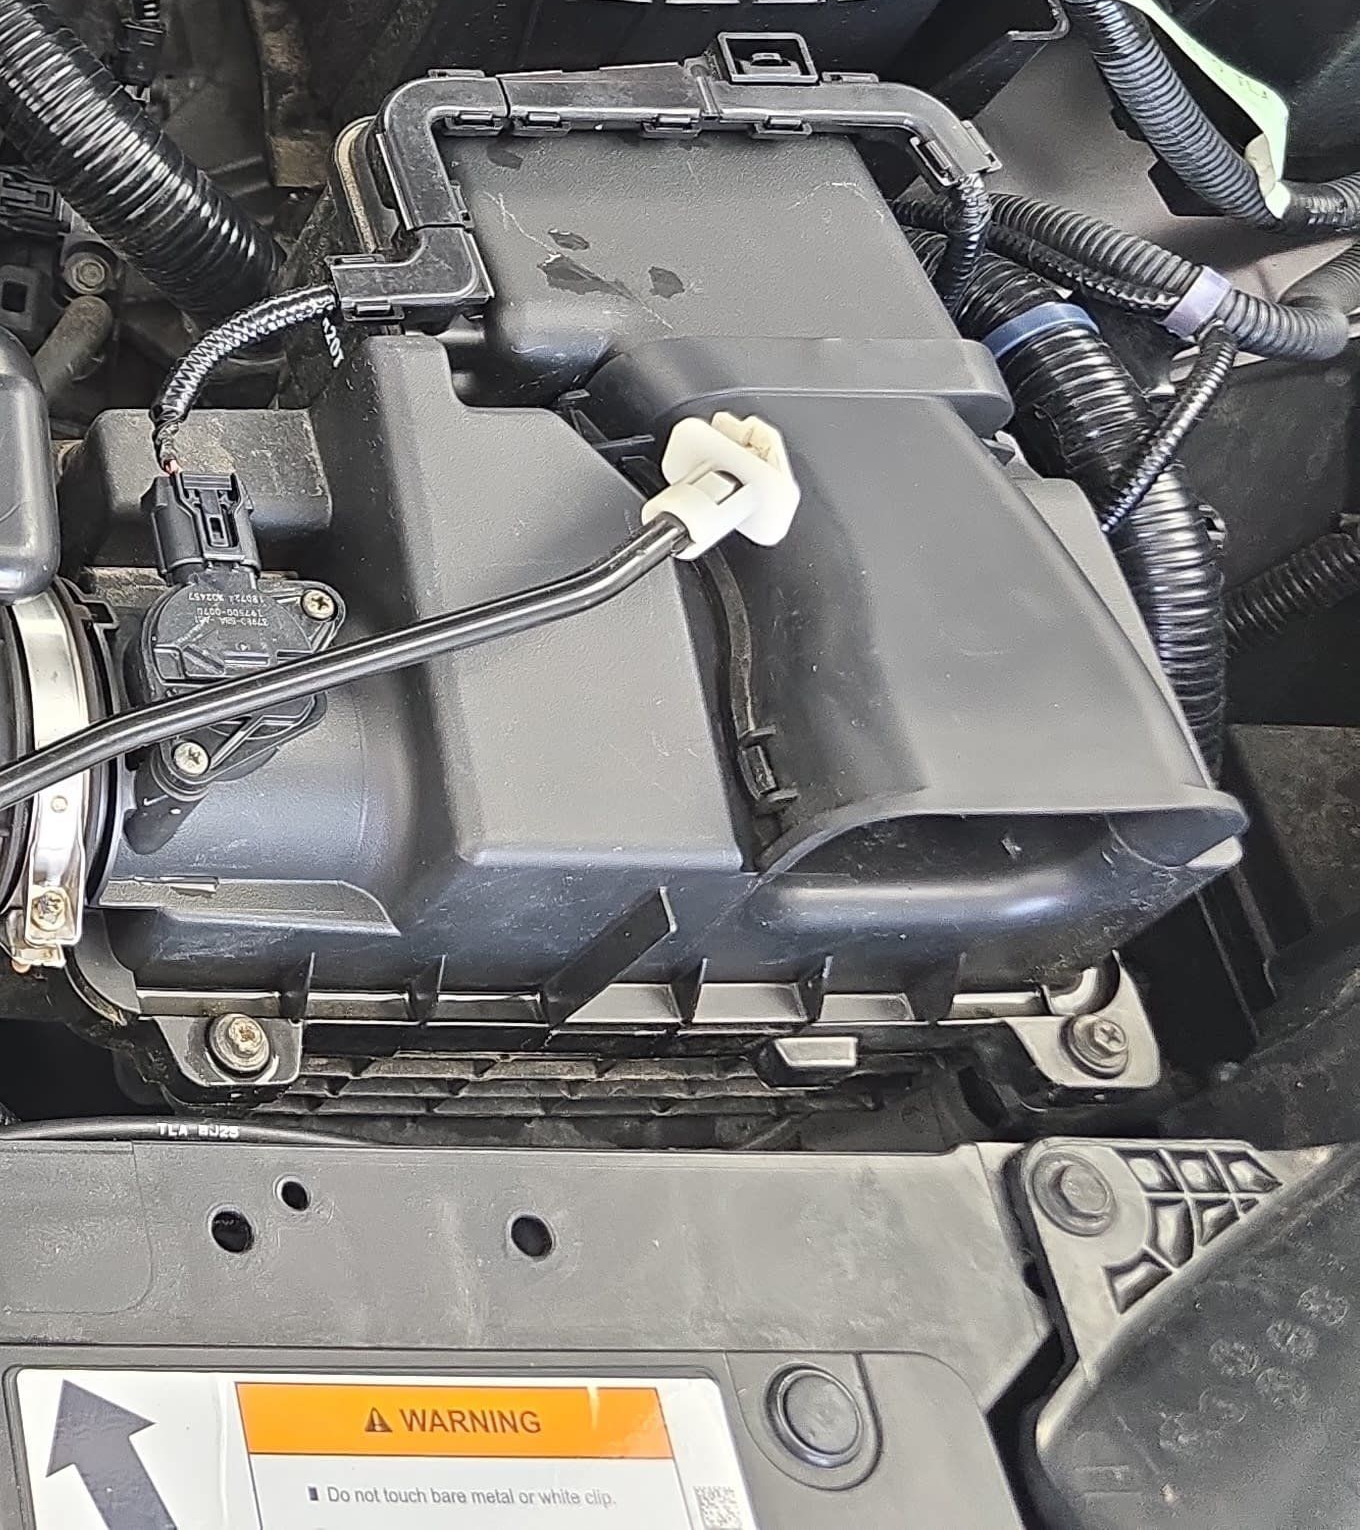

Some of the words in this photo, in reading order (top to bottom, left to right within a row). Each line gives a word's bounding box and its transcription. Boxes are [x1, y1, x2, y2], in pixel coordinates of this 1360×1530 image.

[156, 1122, 188, 1137] TLA
[399, 1408, 542, 1434] WARNING
[327, 1486, 351, 1503] Do
[355, 1488, 381, 1504] not
[384, 1488, 428, 1504] touch
[431, 1489, 467, 1505] bare
[471, 1489, 515, 1505] metal
[519, 1492, 535, 1505] or
[537, 1489, 580, 1506] white
[584, 1489, 618, 1509] clip.
